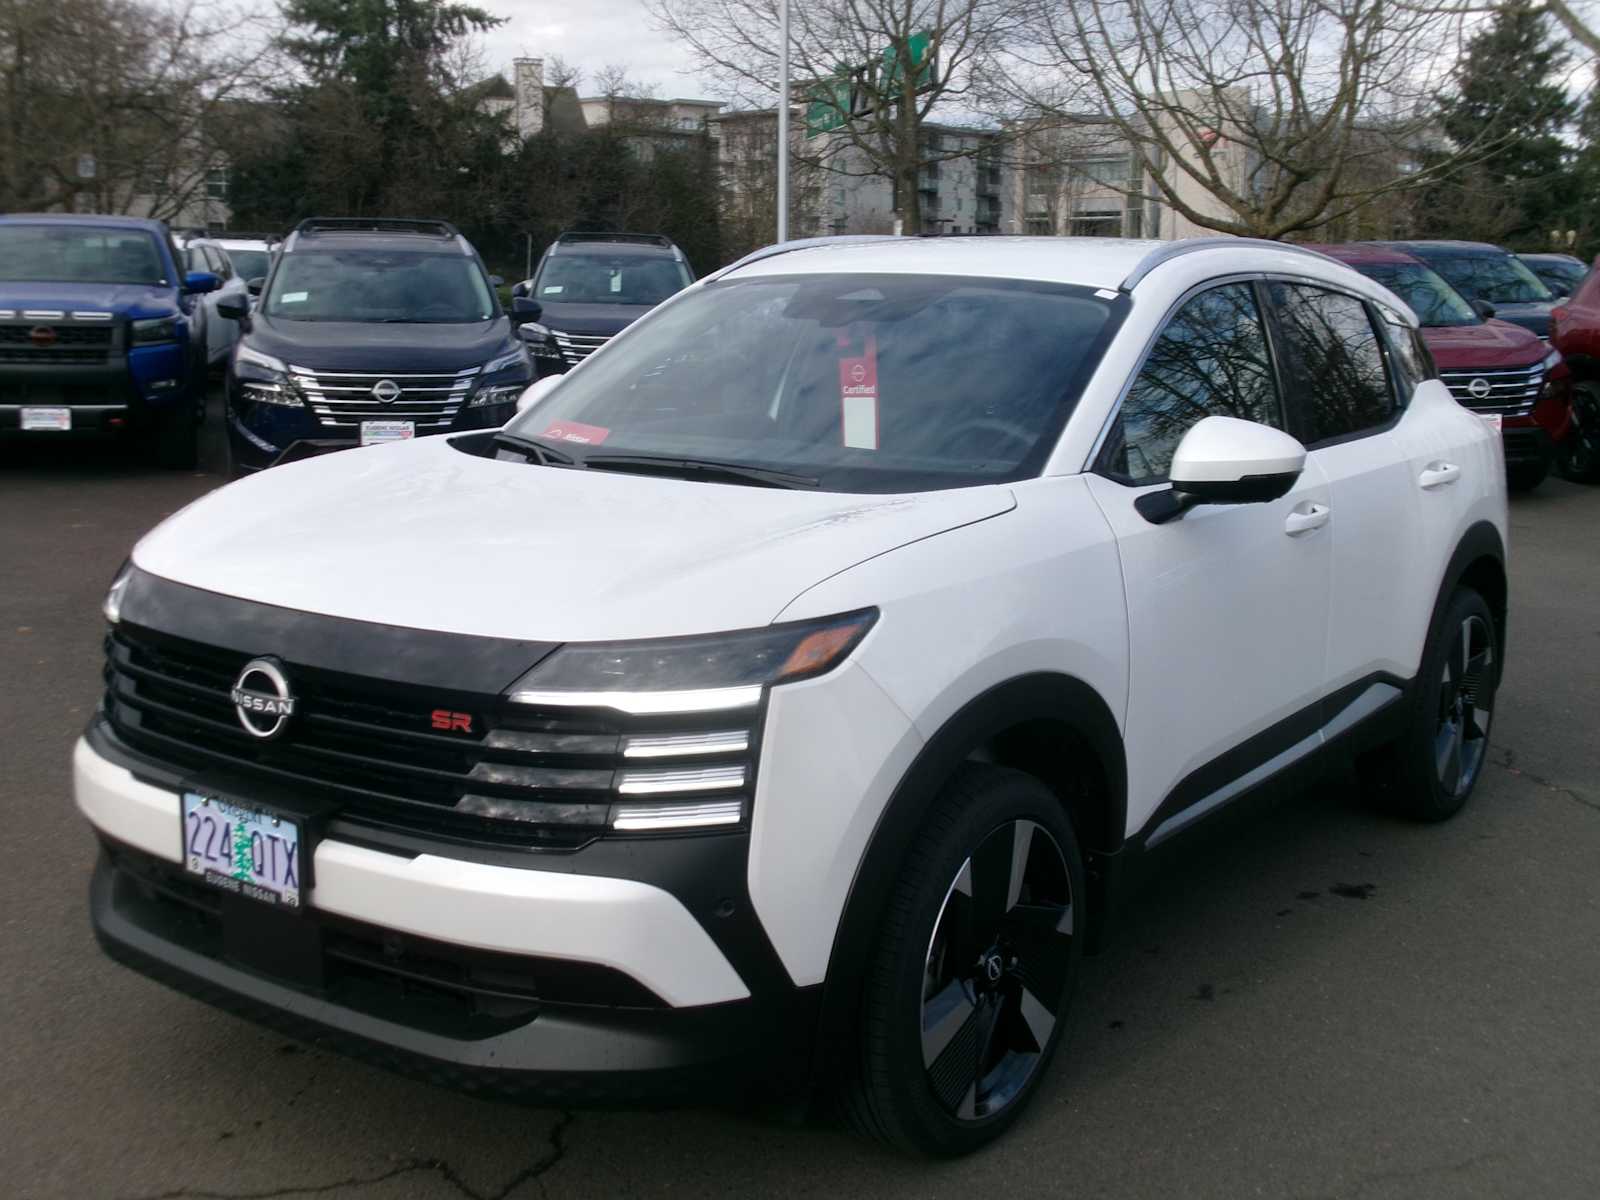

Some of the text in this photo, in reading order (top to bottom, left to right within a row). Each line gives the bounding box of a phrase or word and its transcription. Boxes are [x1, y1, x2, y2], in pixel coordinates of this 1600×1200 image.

[843, 384, 876, 394] Certified
[231, 689, 294, 714] NISSAN
[431, 709, 473, 733] SR
[188, 811, 233, 867] 224
[251, 830, 299, 888] QTX
